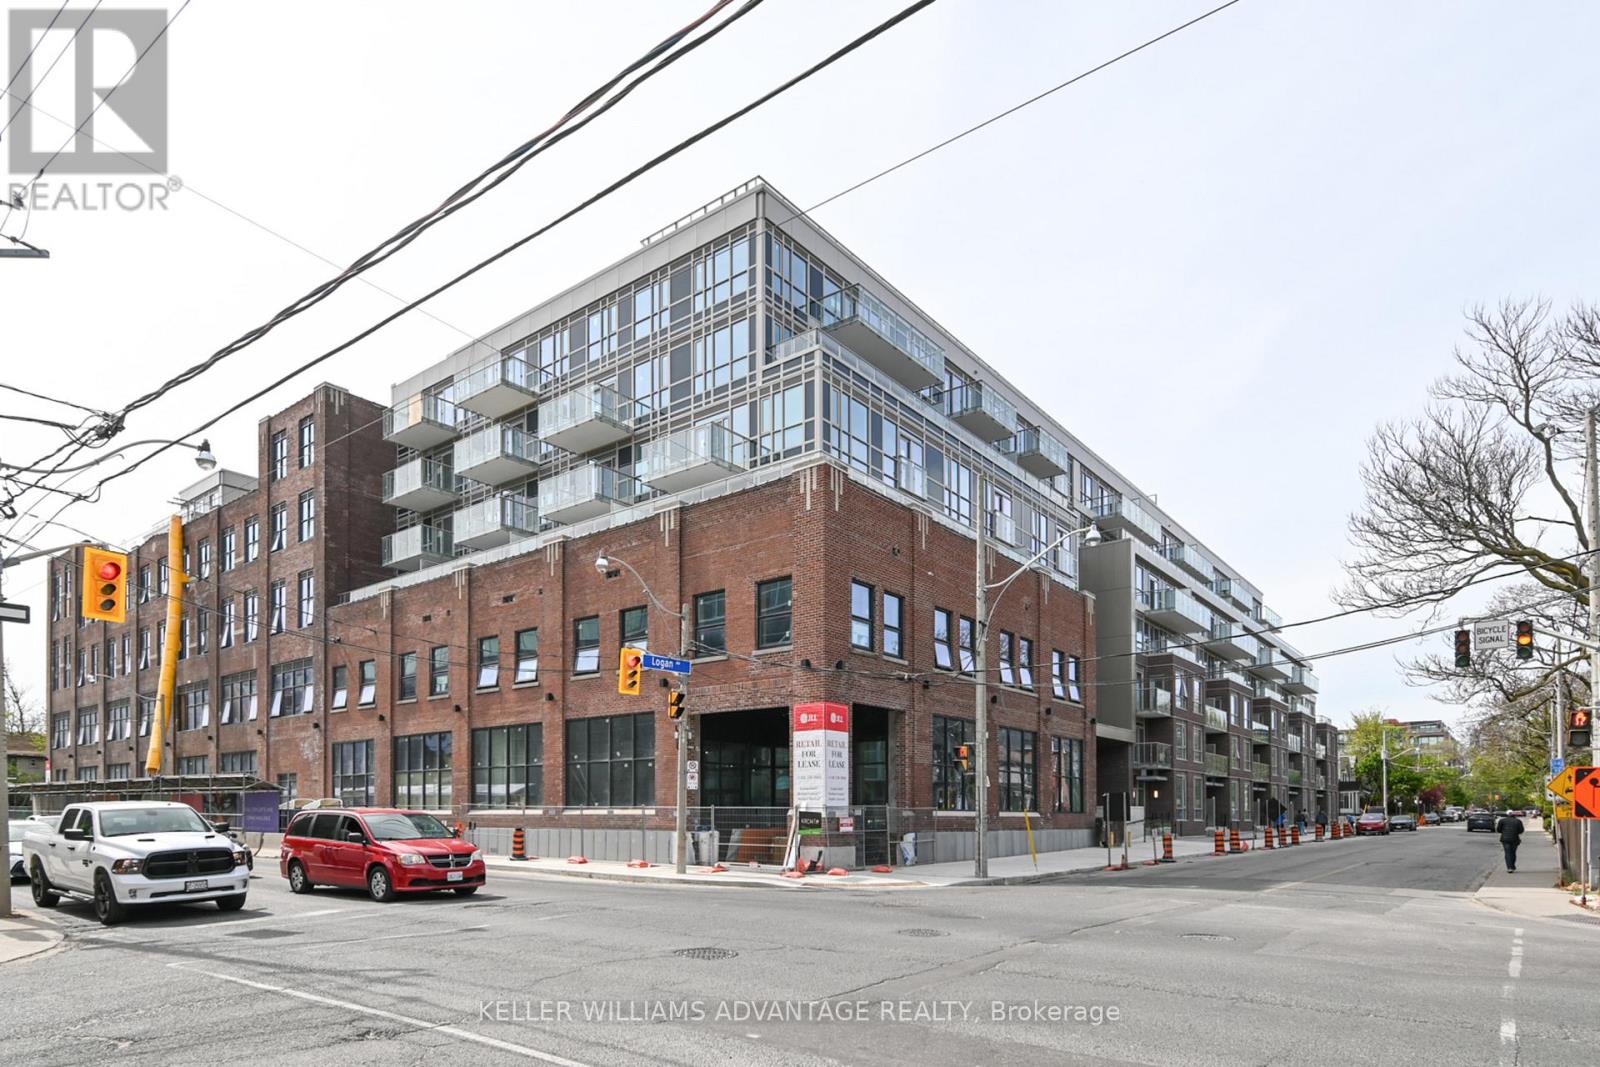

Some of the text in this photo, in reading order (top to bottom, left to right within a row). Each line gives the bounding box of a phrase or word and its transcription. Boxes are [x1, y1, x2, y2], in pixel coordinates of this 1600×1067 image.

[1476, 624, 1506, 635] BICYCLE
[1478, 635, 1505, 644] SIGNAL
[651, 656, 673, 670] Logan
[796, 740, 820, 748] RETAIL
[827, 740, 847, 748] RETAIL
[831, 750, 843, 758] FOR
[797, 760, 821, 768] LEASE
[828, 760, 847, 768] LEASE
